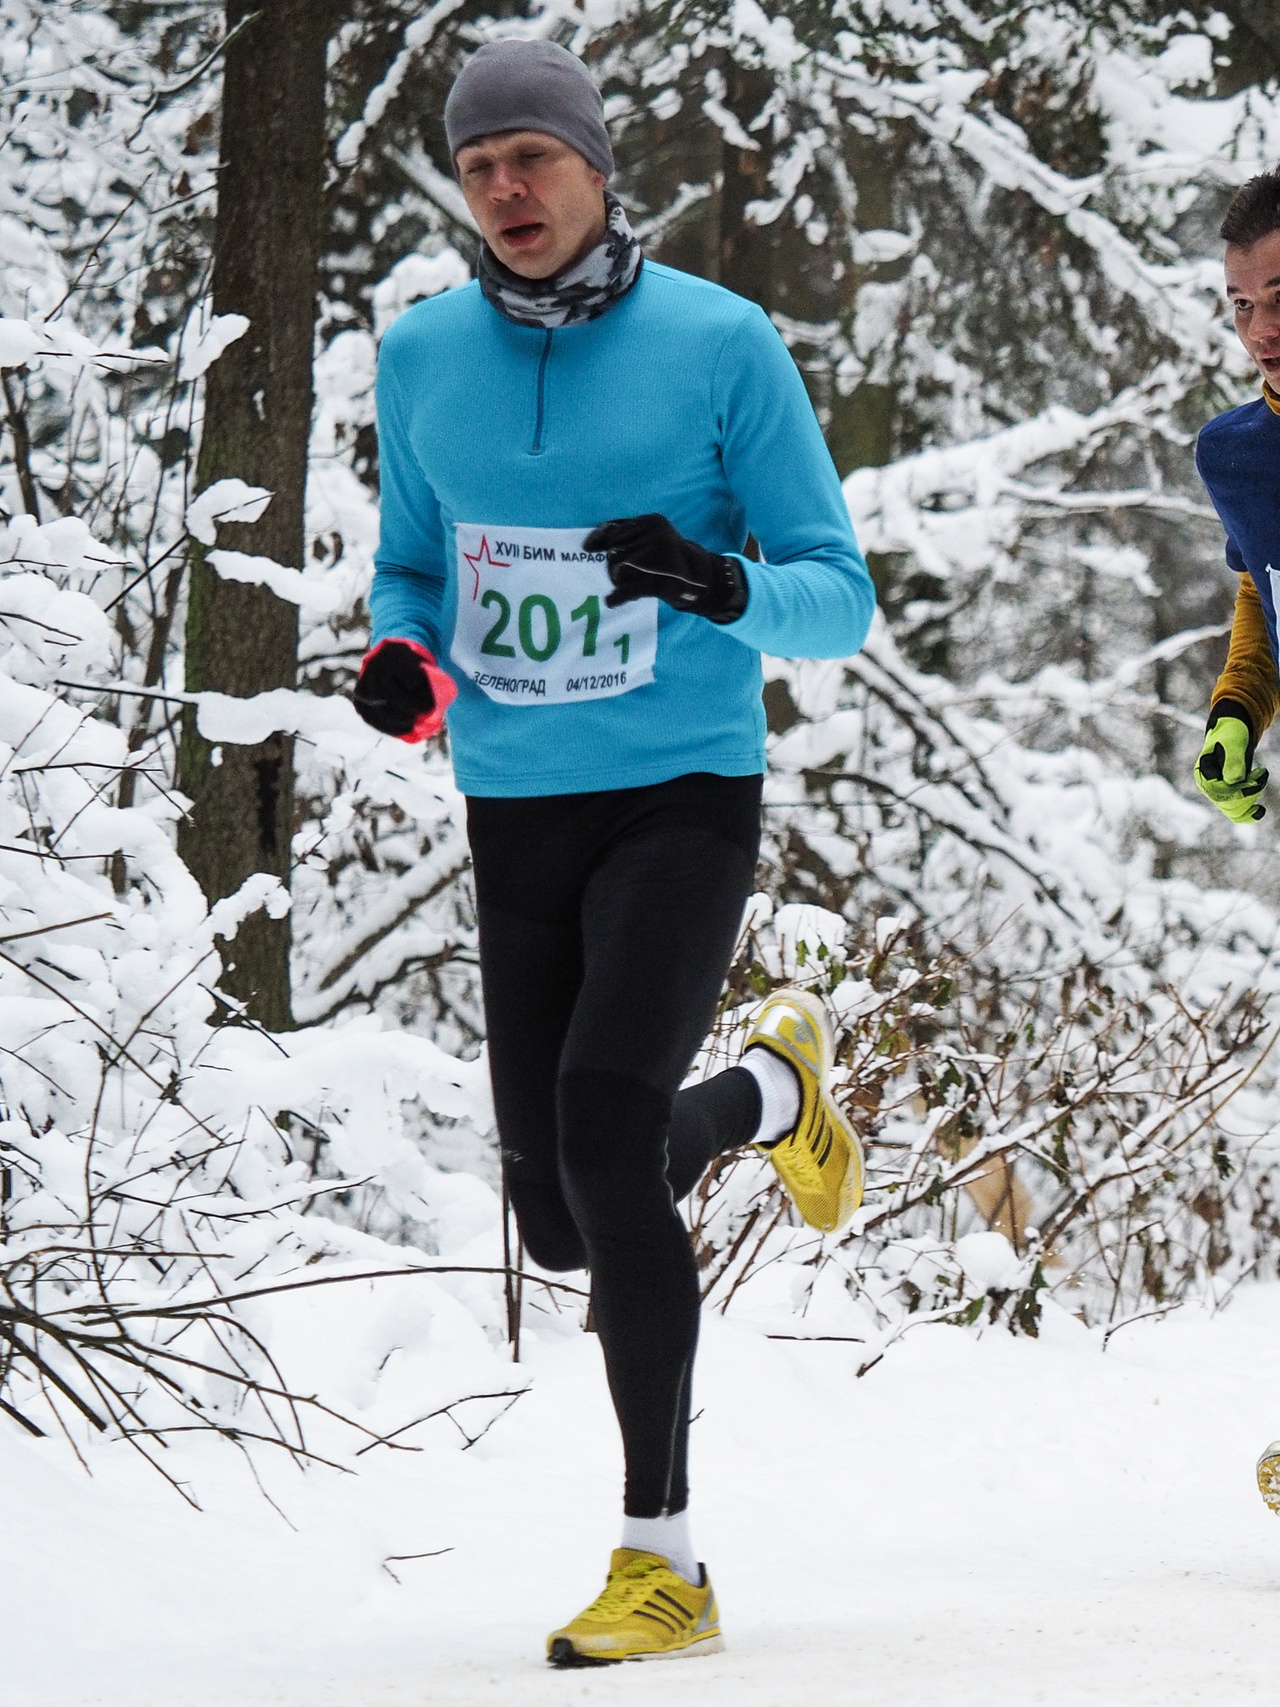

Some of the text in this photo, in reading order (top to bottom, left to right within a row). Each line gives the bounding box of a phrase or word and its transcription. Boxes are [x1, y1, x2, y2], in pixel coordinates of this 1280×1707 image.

[523, 546, 555, 562] БИМ
[473, 671, 627, 696] ЗЕЛЕНОГРАД 04/12/2016
